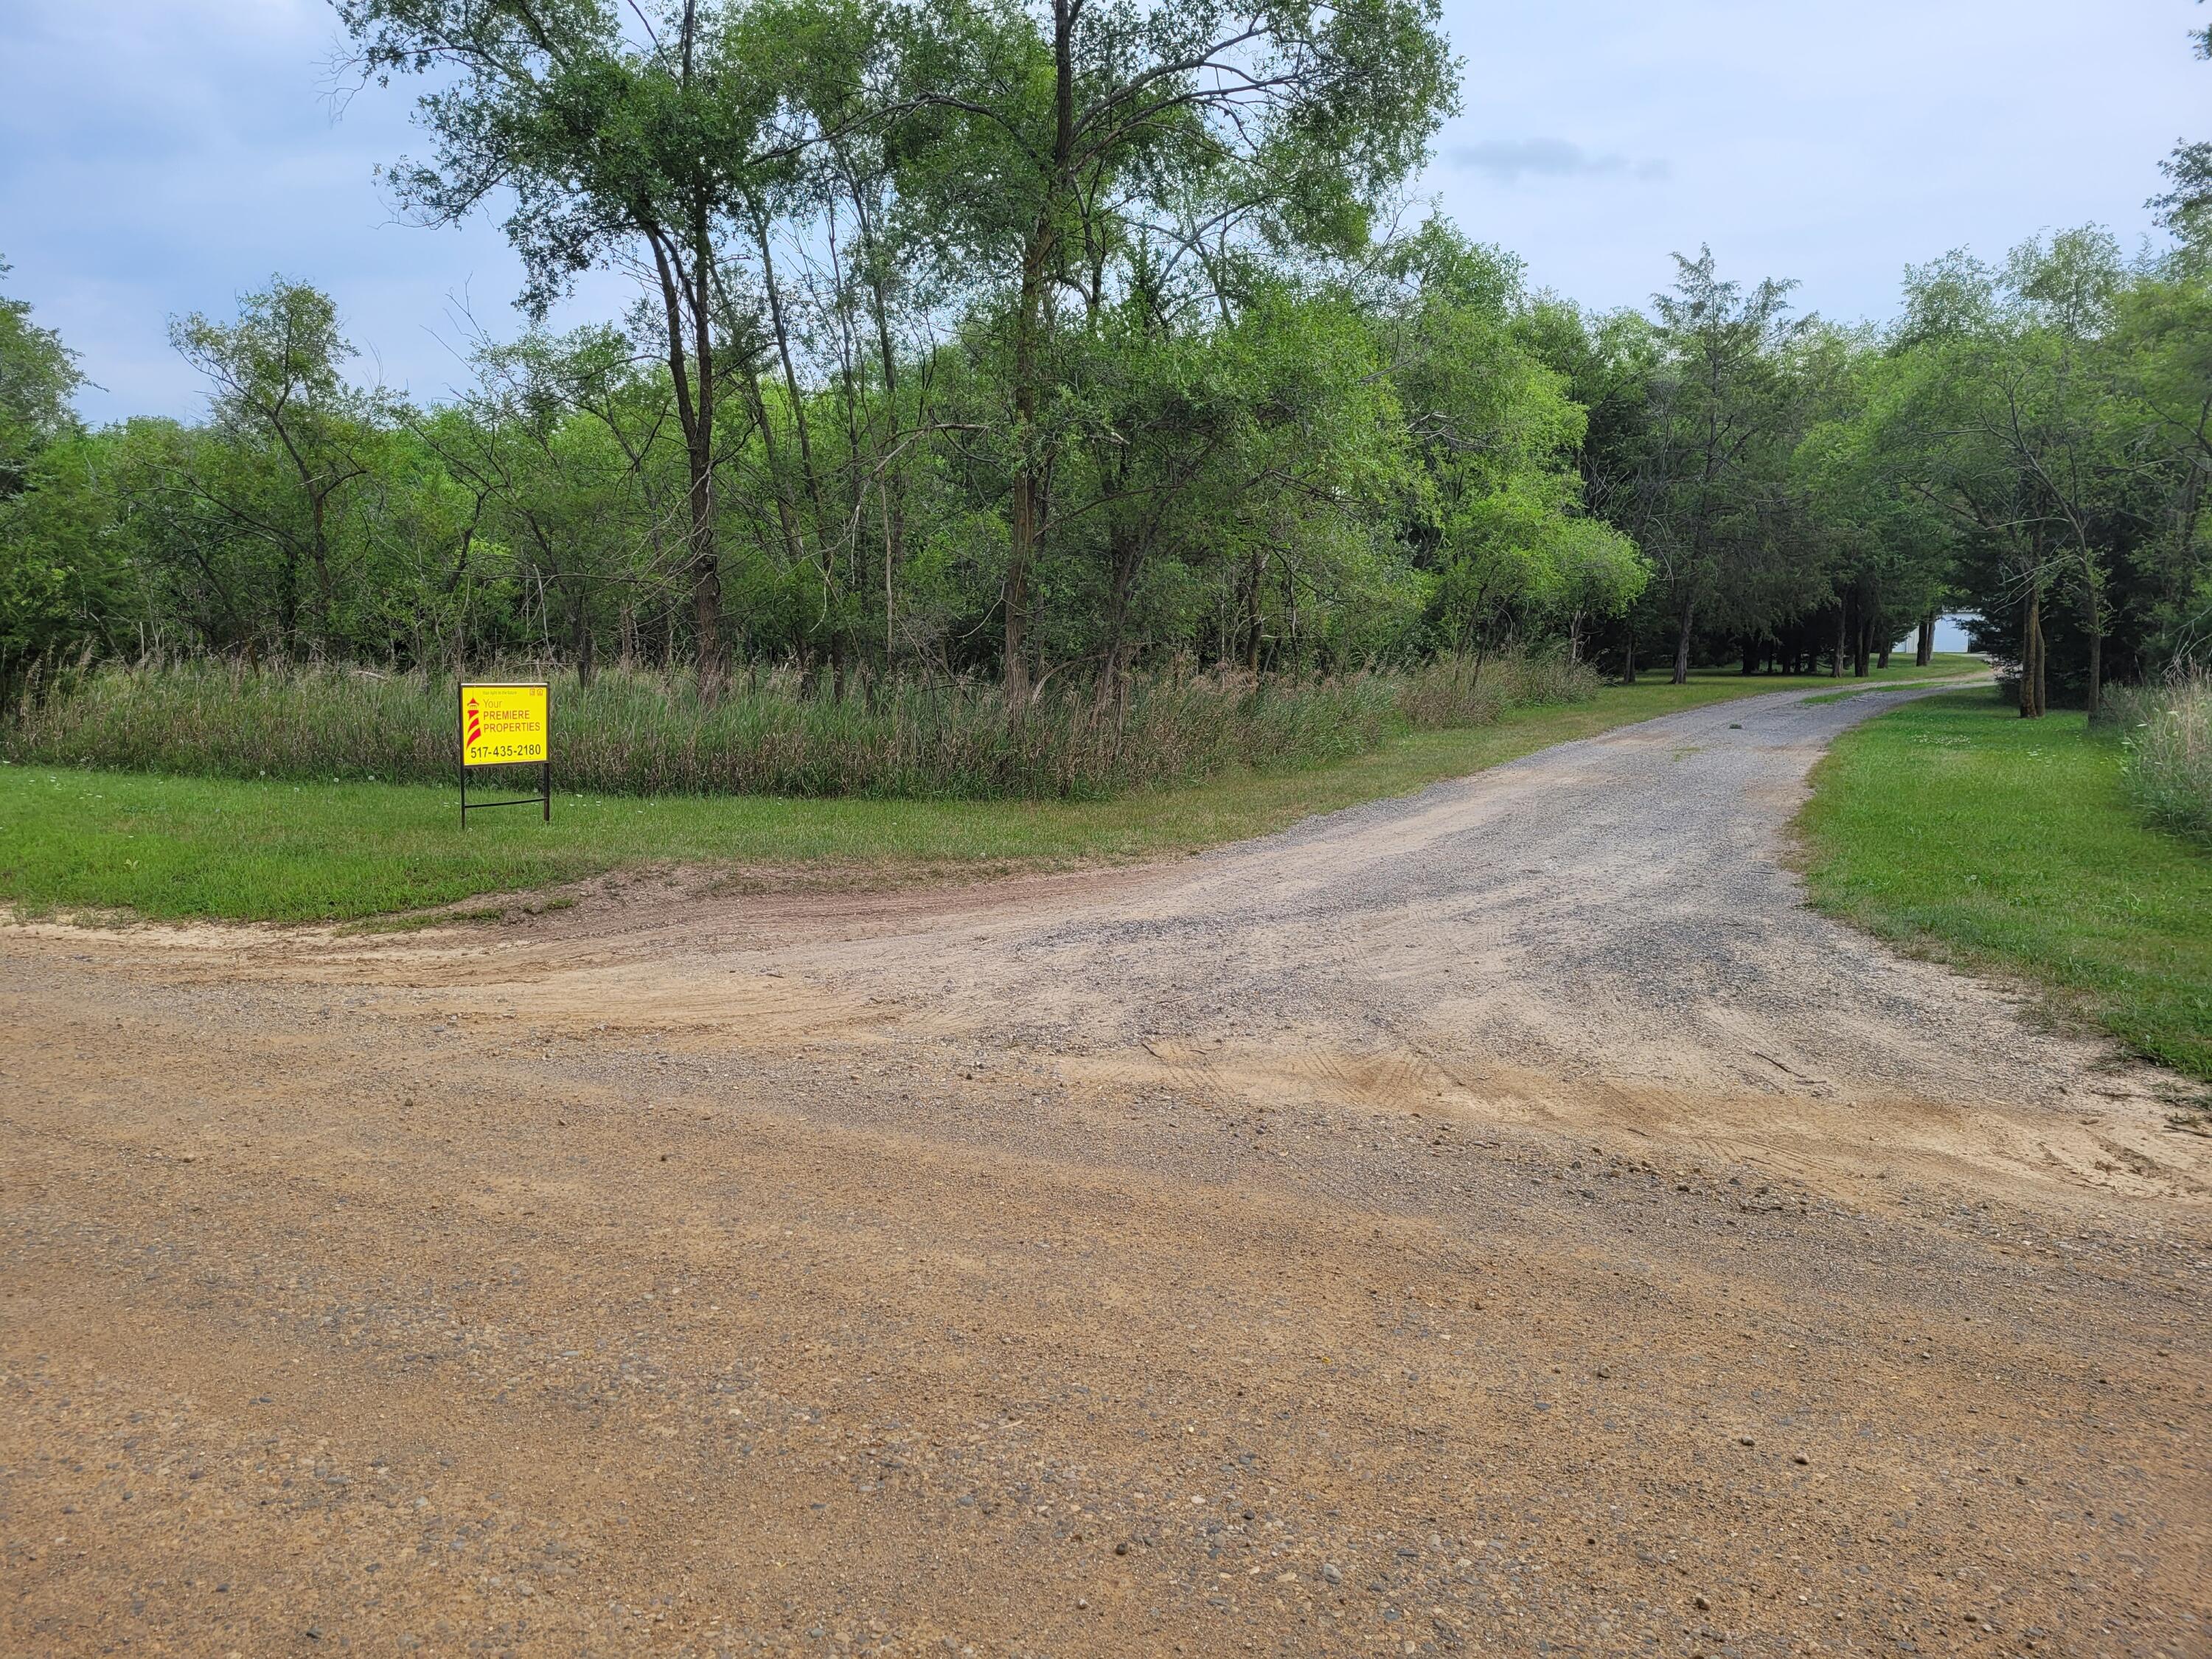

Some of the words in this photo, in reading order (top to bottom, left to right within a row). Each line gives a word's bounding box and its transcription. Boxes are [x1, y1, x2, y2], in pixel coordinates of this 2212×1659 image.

[483, 699, 503, 709] Your
[484, 710, 530, 720] PREMIERE
[484, 722, 540, 732] PROPERTIES
[471, 744, 541, 759] 517-435-2180
